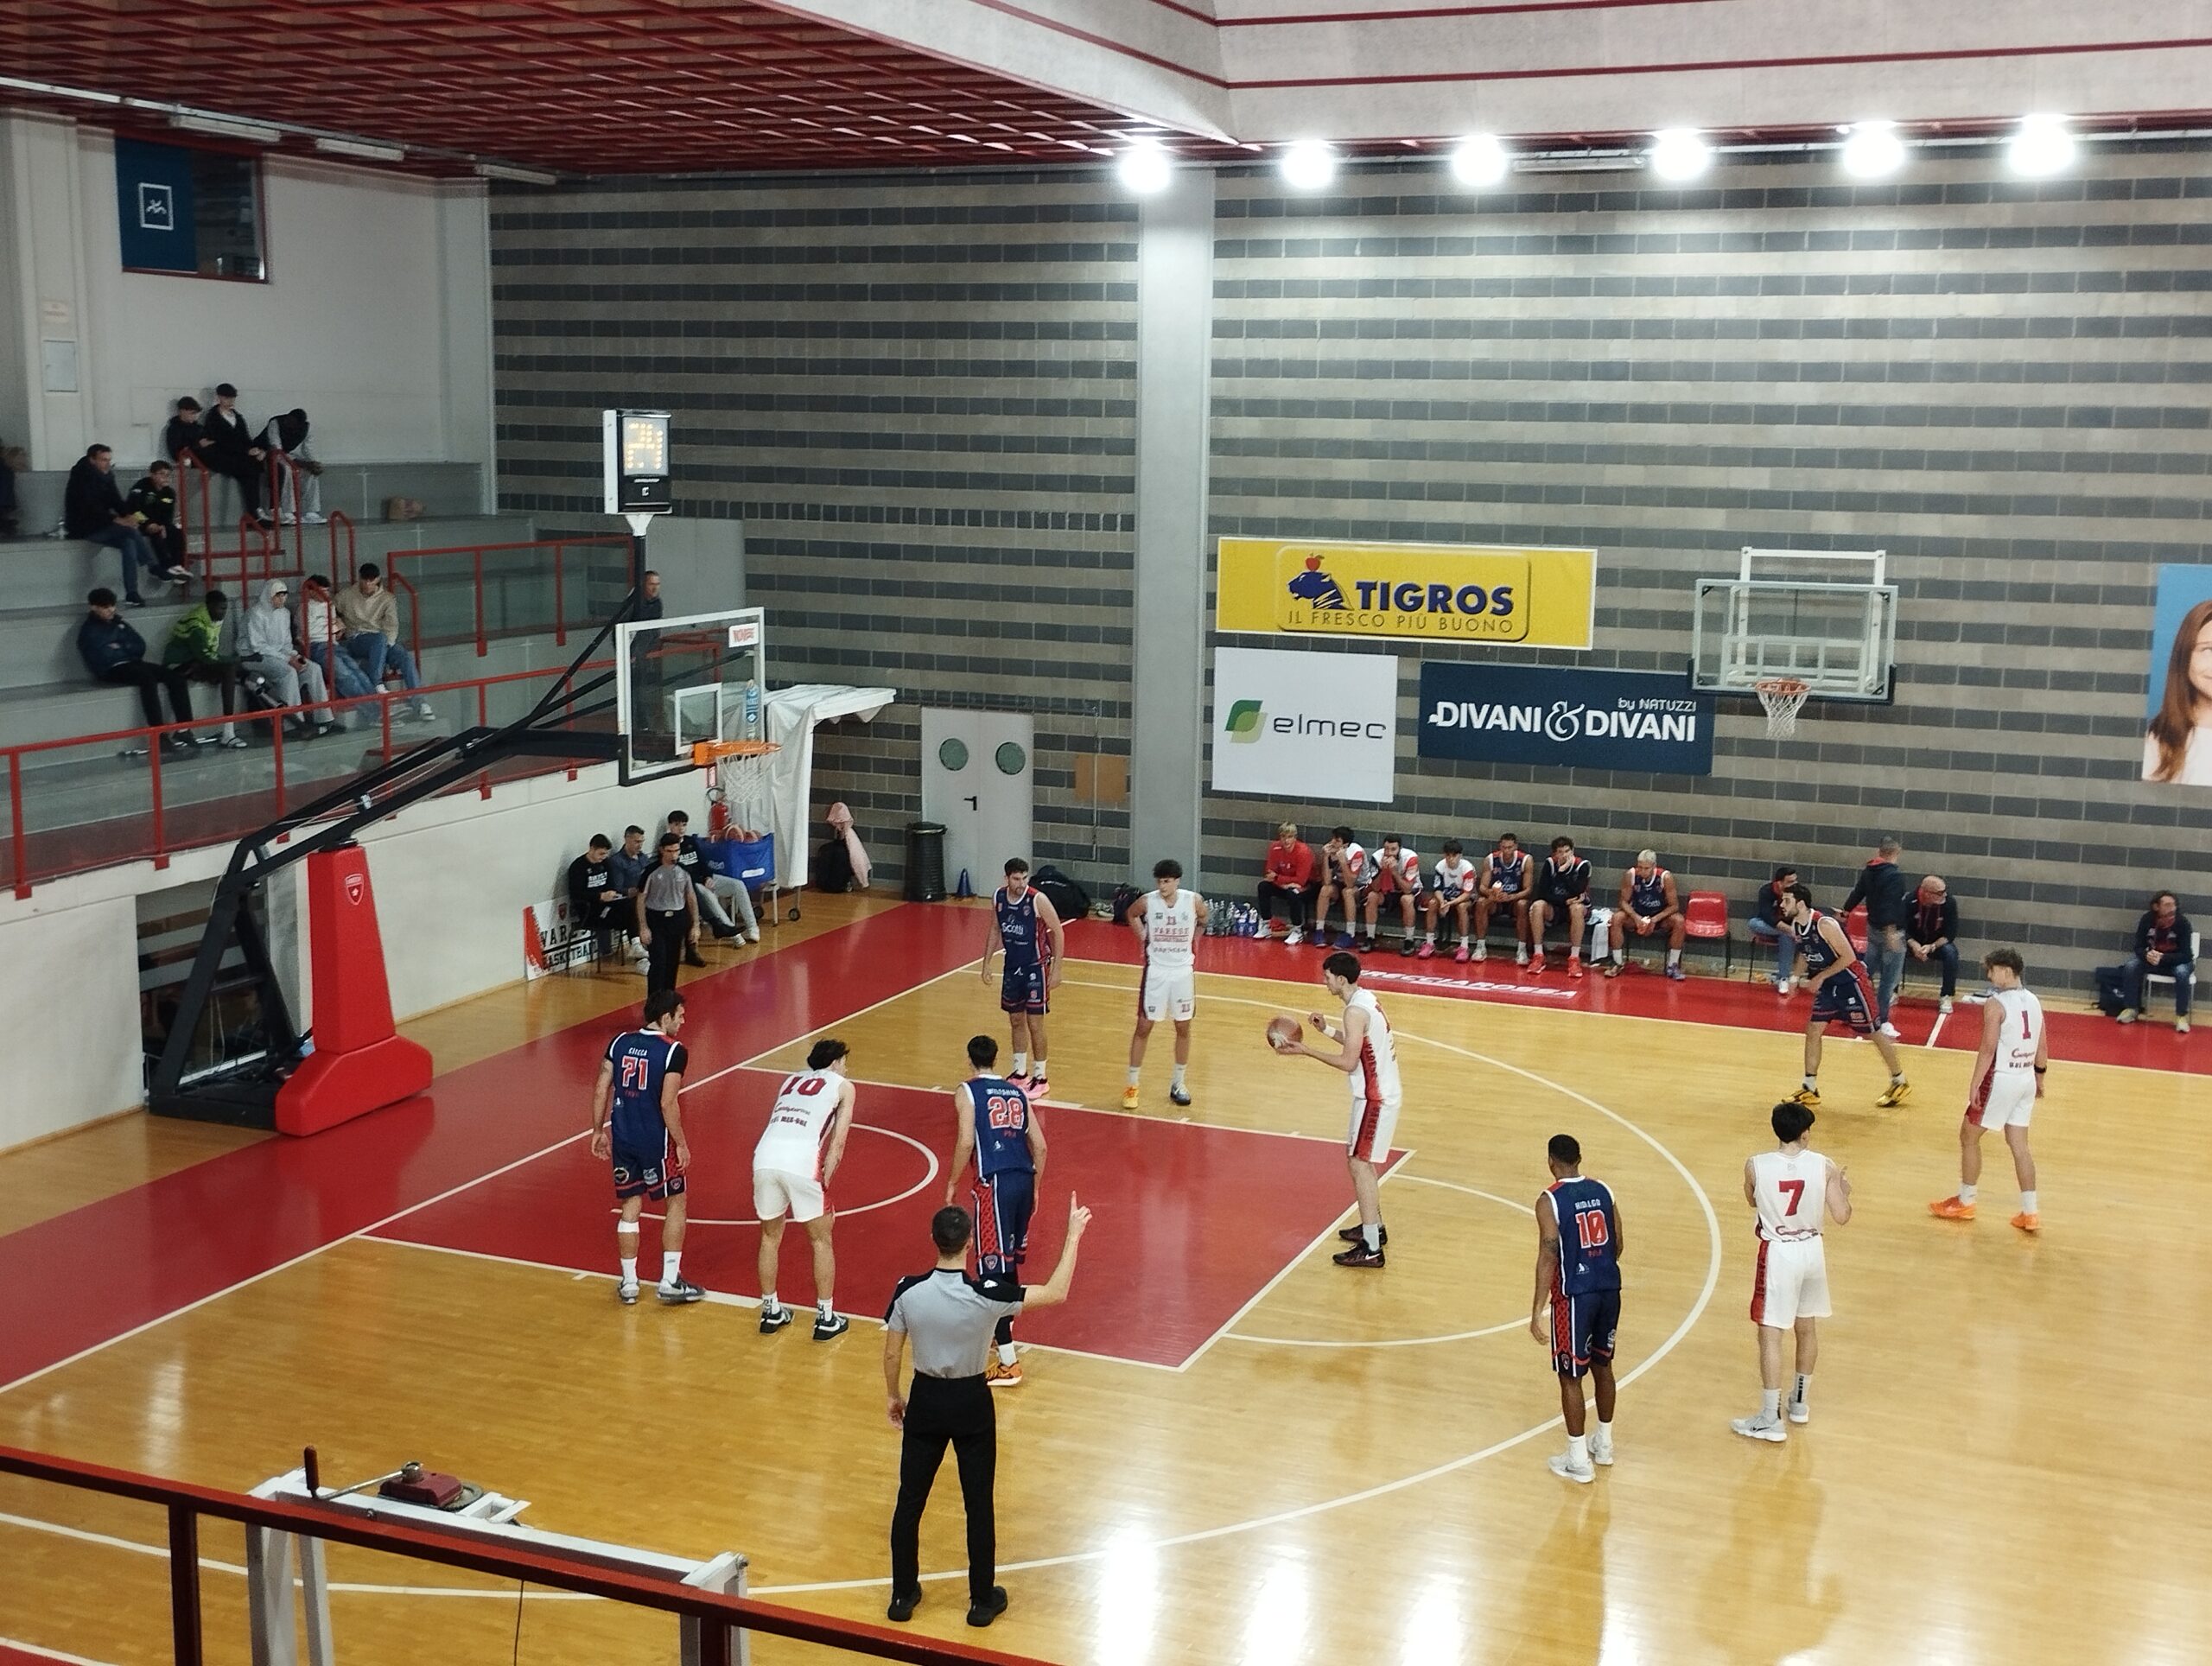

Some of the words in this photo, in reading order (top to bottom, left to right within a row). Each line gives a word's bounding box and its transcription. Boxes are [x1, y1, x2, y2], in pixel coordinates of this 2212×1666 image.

[1356, 580, 1515, 617] TIGROS
[1287, 610, 1303, 625] IL
[1311, 612, 1385, 628] FRESCO
[1396, 614, 1427, 630] PIÙ
[1438, 616, 1514, 633] BUONO
[1617, 696, 1636, 710] by
[1638, 698, 1697, 712] NATUZZI
[1273, 713, 1387, 740] elmec
[1436, 701, 1542, 733] DIVANI
[1585, 709, 1697, 742] DIVANI
[2021, 1010, 2031, 1040] 1
[621, 1055, 649, 1091] 71
[780, 1076, 827, 1097] 10
[987, 1096, 1025, 1129] 28
[1778, 1180, 1805, 1217] 7
[1575, 1209, 1609, 1249] 10
